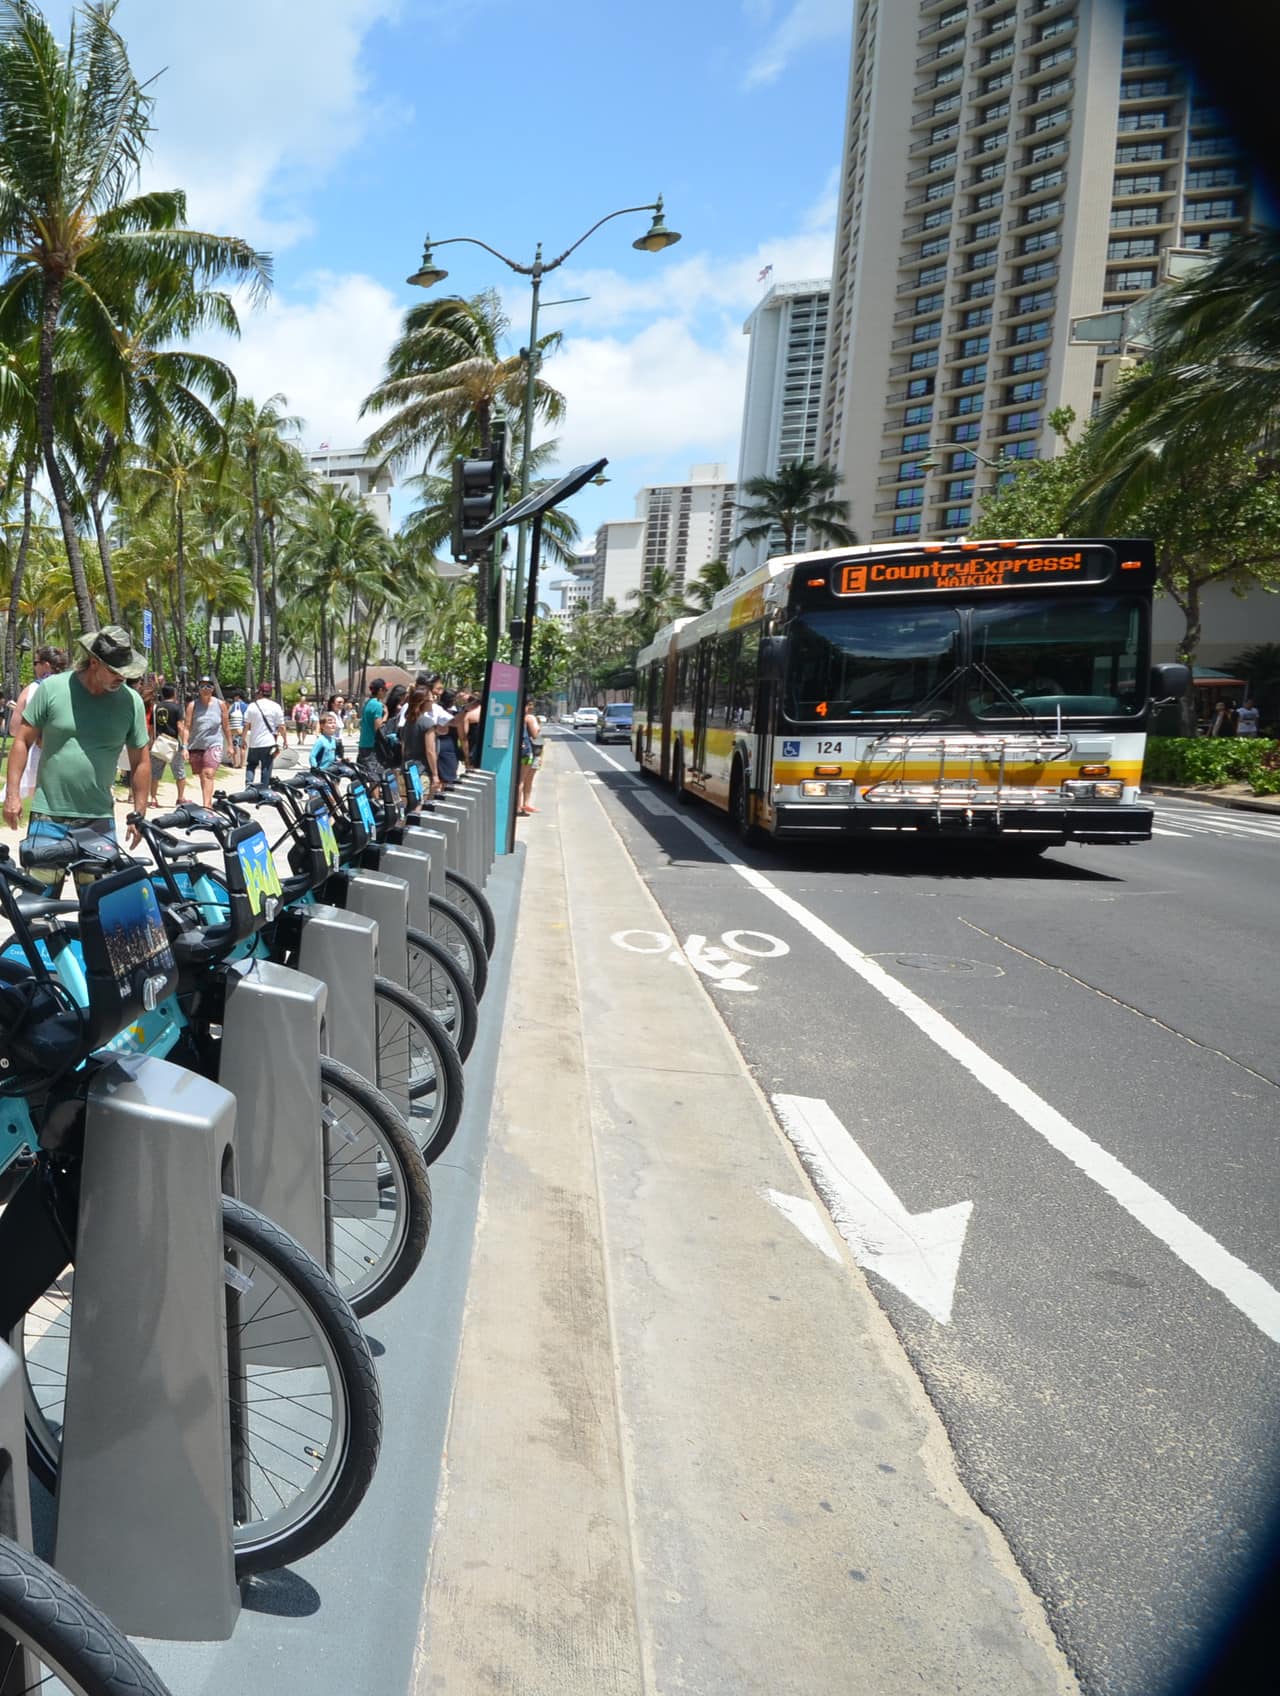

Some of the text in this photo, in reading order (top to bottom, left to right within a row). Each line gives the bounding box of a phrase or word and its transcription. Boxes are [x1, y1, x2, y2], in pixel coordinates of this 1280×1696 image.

[843, 553, 1082, 592] E CountryExpress!
[936, 573, 1004, 588] WAIKIKI
[816, 701, 828, 717] 4
[817, 741, 842, 754] 124
